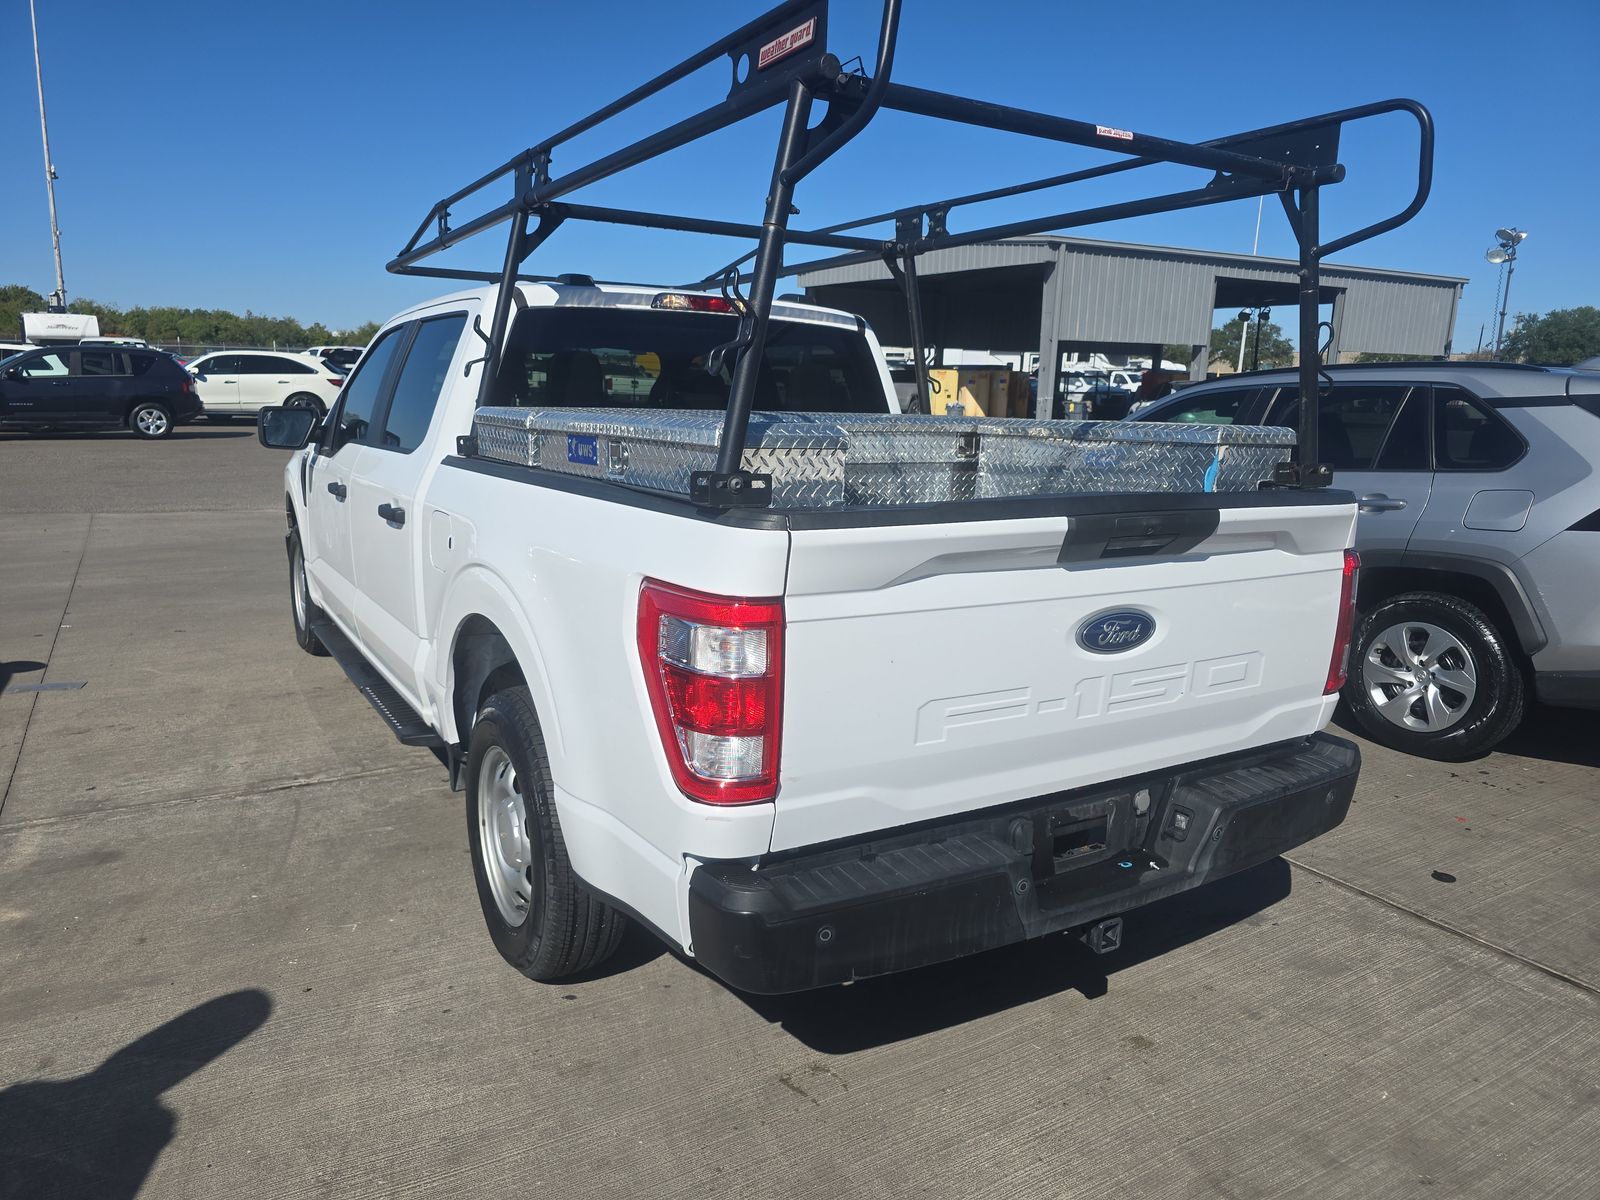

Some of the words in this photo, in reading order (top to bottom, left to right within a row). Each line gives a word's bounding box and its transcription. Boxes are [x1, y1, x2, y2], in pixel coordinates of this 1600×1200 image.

[761, 37, 789, 60] weather
[789, 22, 812, 47] guard
[578, 443, 593, 458] UWS
[1098, 619, 1142, 646] Ford
[914, 650, 1266, 746] F-150
